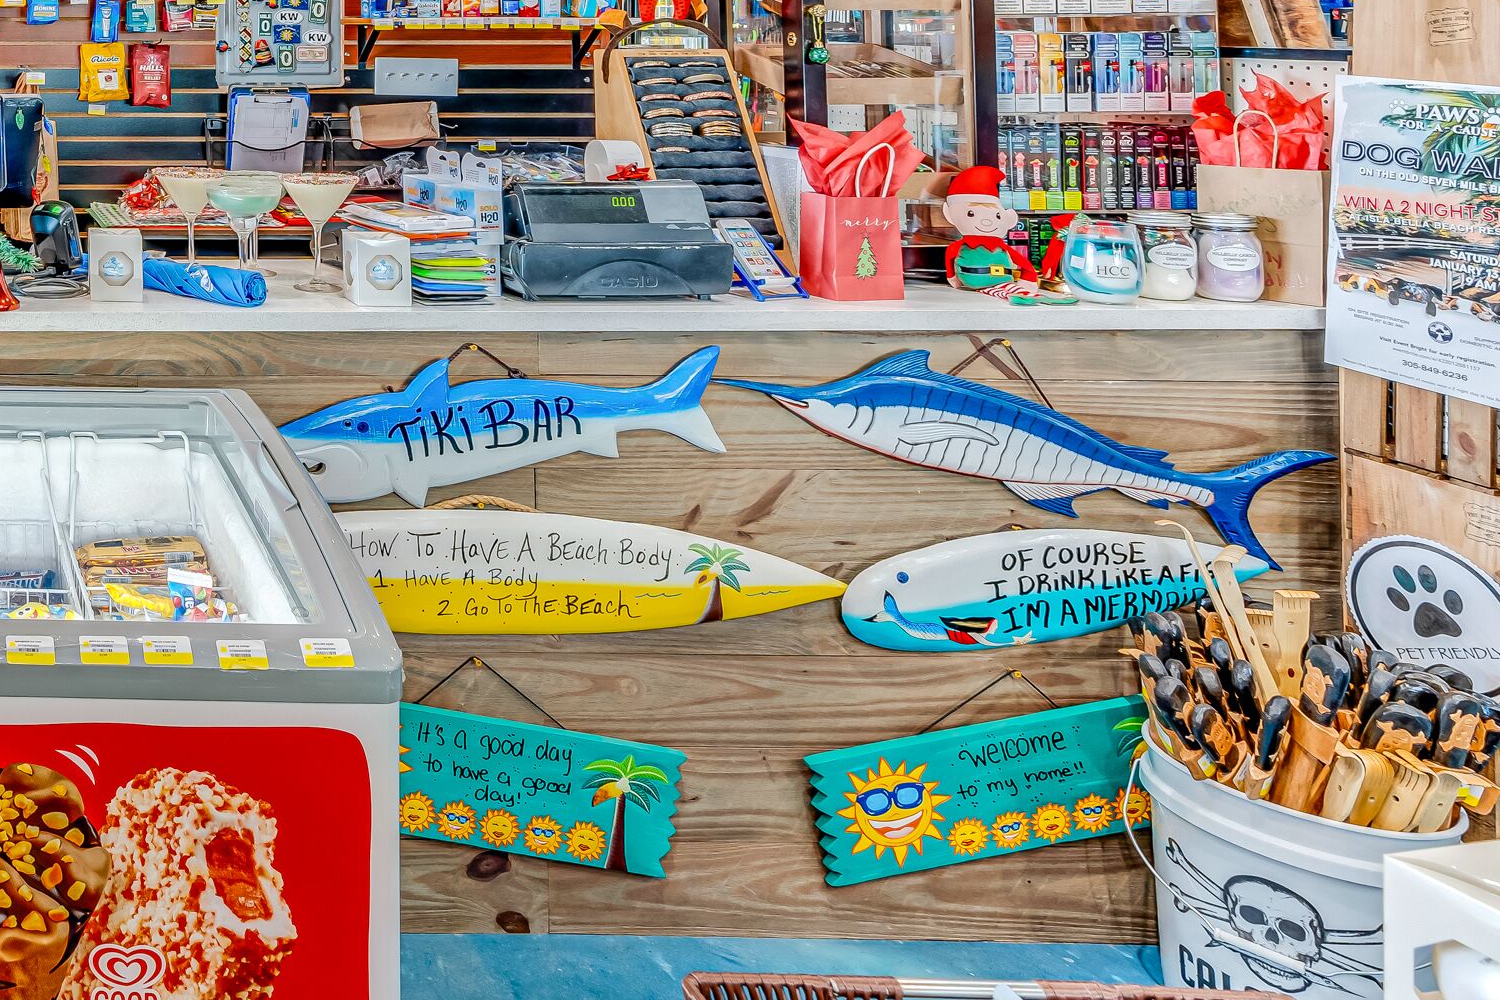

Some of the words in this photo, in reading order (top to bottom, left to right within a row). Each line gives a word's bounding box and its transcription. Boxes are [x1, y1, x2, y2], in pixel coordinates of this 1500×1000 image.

[280, 12, 299, 21] KW
[308, 33, 327, 42] KW
[1415, 103, 1481, 125] PAWS
[1341, 139, 1423, 171] DOG
[1359, 166, 1374, 177] ON
[1377, 169, 1397, 179] THE
[1399, 172, 1419, 183] OLD
[1421, 175, 1457, 188] SEVEN
[1459, 180, 1487, 192] MILE
[1343, 194, 1378, 211] WIN
[1383, 199, 1395, 212] A
[1400, 200, 1410, 214] 2
[1415, 201, 1477, 220] NIGHT
[839, 215, 897, 231] merry
[1348, 213, 1360, 221] AT
[1393, 216, 1430, 229] BELLA
[1434, 221, 1474, 233] BEACH
[1095, 265, 1131, 278] HCC
[1428, 257, 1483, 277] JANUARY
[599, 274, 660, 290] CASIO
[1474, 280, 1496, 292] AM
[478, 395, 583, 450] BAR
[517, 532, 536, 564] A
[1001, 547, 1034, 572] OF
[1042, 540, 1147, 569] COURSE
[462, 569, 477, 586] A
[984, 580, 1007, 603] I
[1156, 567, 1175, 587] A
[464, 597, 489, 617] Go
[1002, 600, 1050, 634] I'M
[1060, 599, 1080, 628] A
[1395, 646, 1425, 660] PET
[416, 722, 446, 748] It's
[453, 730, 469, 750] a
[478, 733, 526, 760] good
[535, 740, 573, 777] day
[957, 728, 1068, 769] Welcome
[422, 753, 443, 774] to
[452, 760, 490, 780] have
[497, 770, 512, 788] a
[521, 777, 572, 797] good
[956, 779, 980, 801] to
[986, 775, 1020, 802] my
